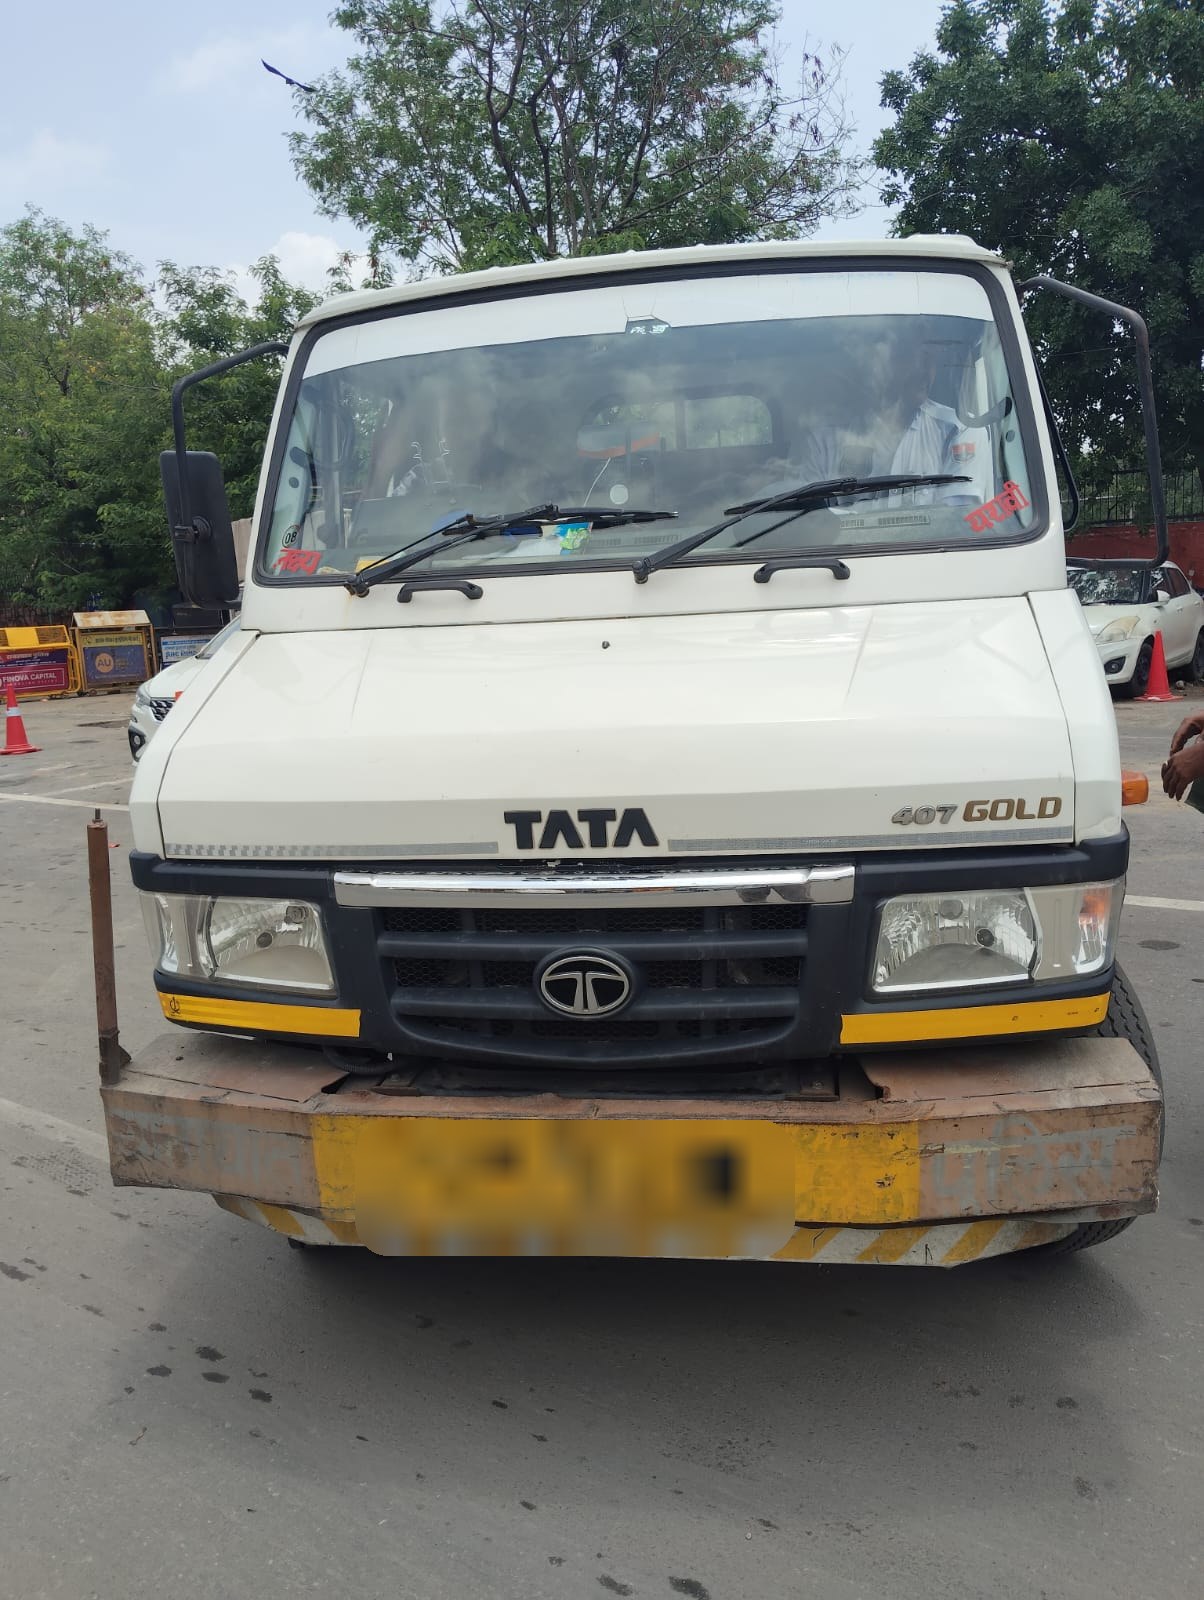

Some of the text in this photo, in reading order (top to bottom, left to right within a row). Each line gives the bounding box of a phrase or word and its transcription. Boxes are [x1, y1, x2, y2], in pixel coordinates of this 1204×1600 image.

[284, 531, 298, 544] 08
[2, 672, 57, 683] FINOVA CAPITAL
[891, 796, 1063, 826] 407 GOLD
[503, 808, 660, 850] TATA
